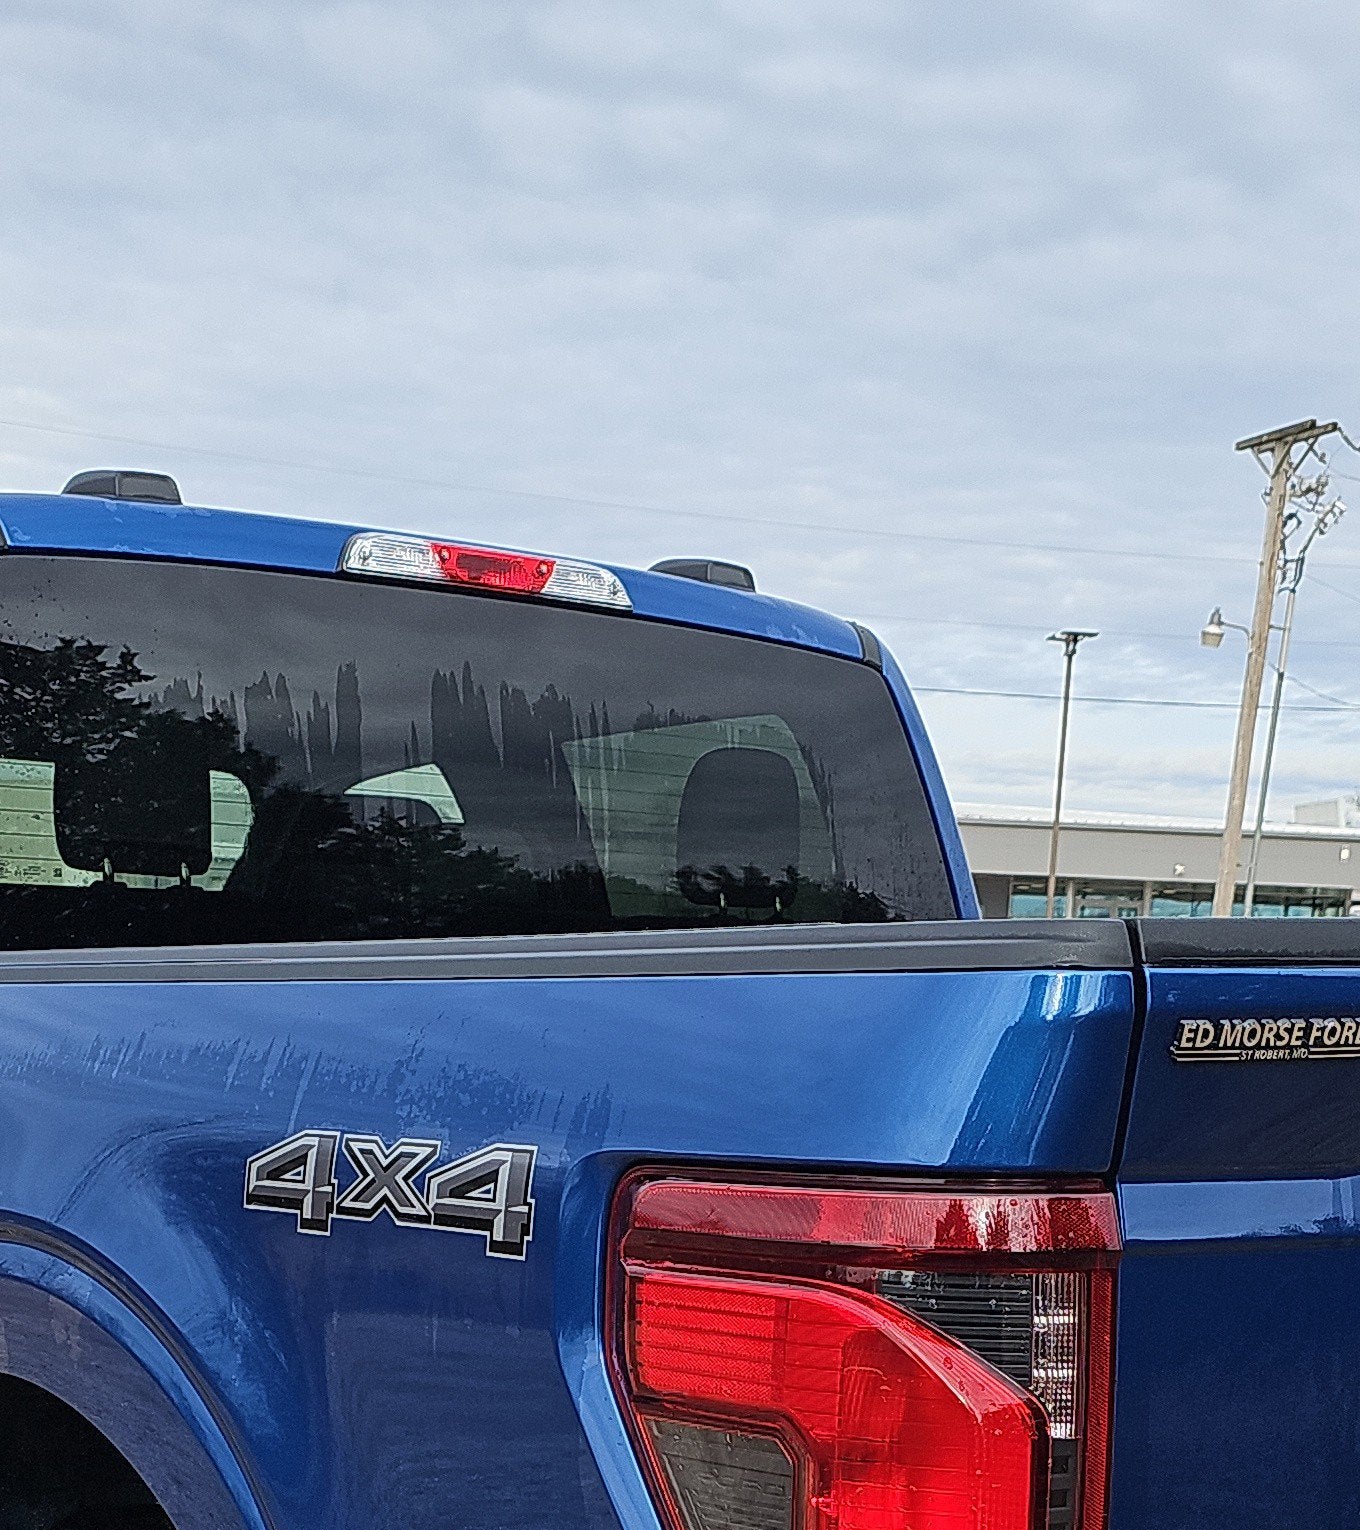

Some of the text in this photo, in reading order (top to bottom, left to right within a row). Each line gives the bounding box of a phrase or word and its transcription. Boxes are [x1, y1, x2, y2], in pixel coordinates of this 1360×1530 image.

[1179, 1018, 1215, 1048] ED
[1218, 1018, 1306, 1048] MORSE
[1240, 1050, 1253, 1060] ST
[1291, 1048, 1309, 1059] MO
